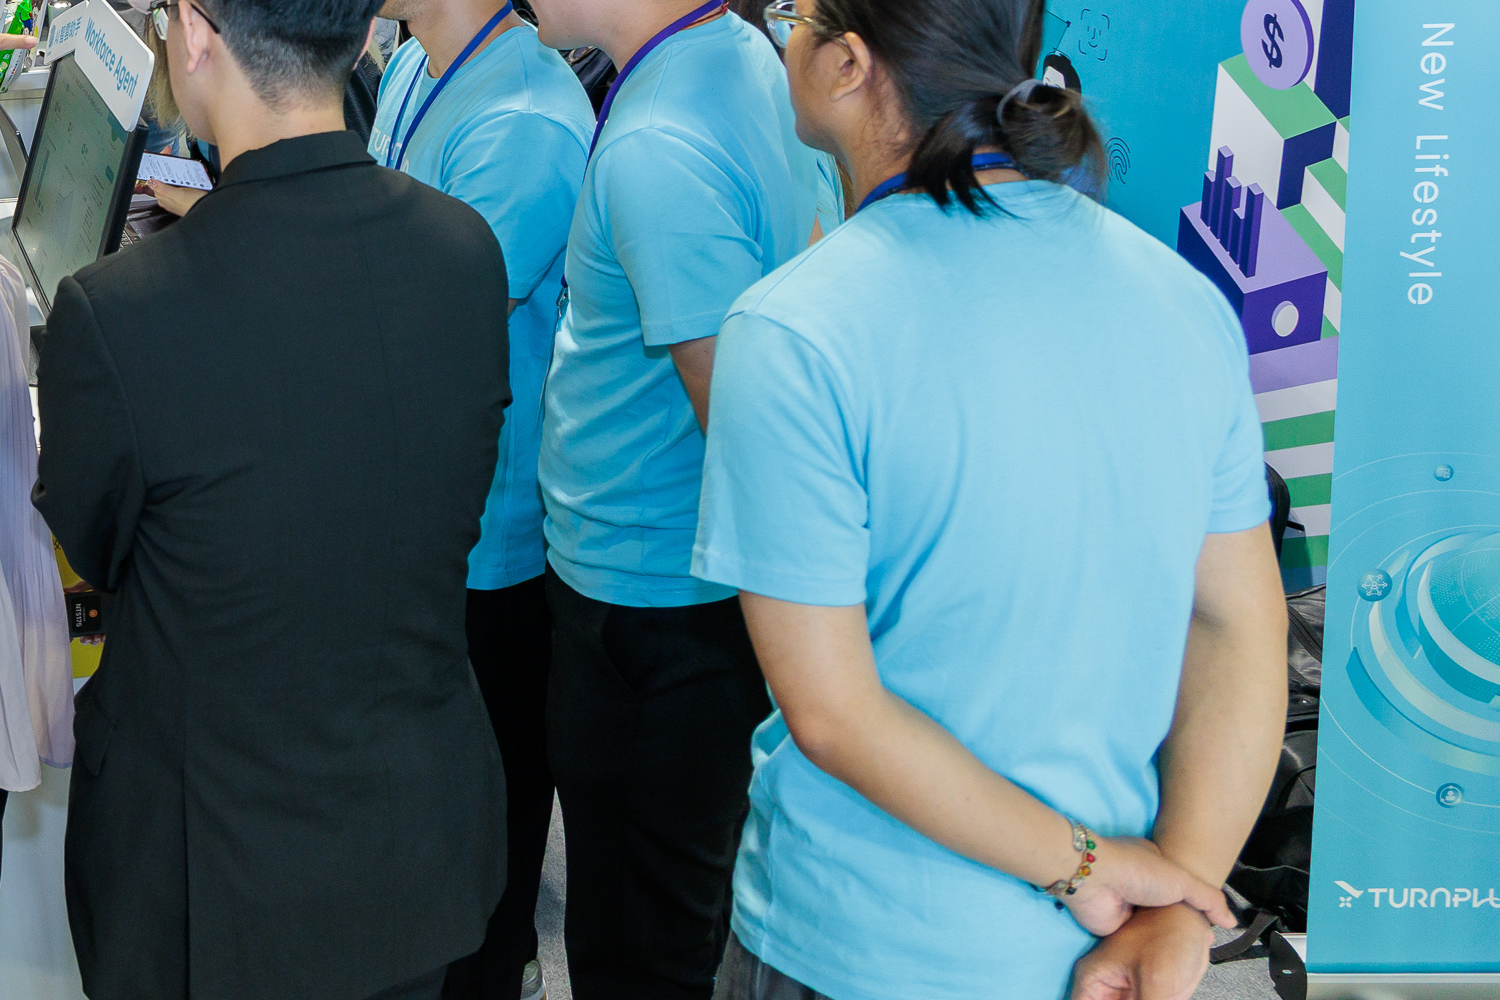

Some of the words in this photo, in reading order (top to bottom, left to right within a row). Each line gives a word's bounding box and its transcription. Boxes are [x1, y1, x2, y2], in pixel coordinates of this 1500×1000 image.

[84, 17, 115, 72] Workforce
[113, 55, 138, 98] Agent
[1418, 22, 1455, 111] New
[1400, 133, 1450, 307] Lifestyle
